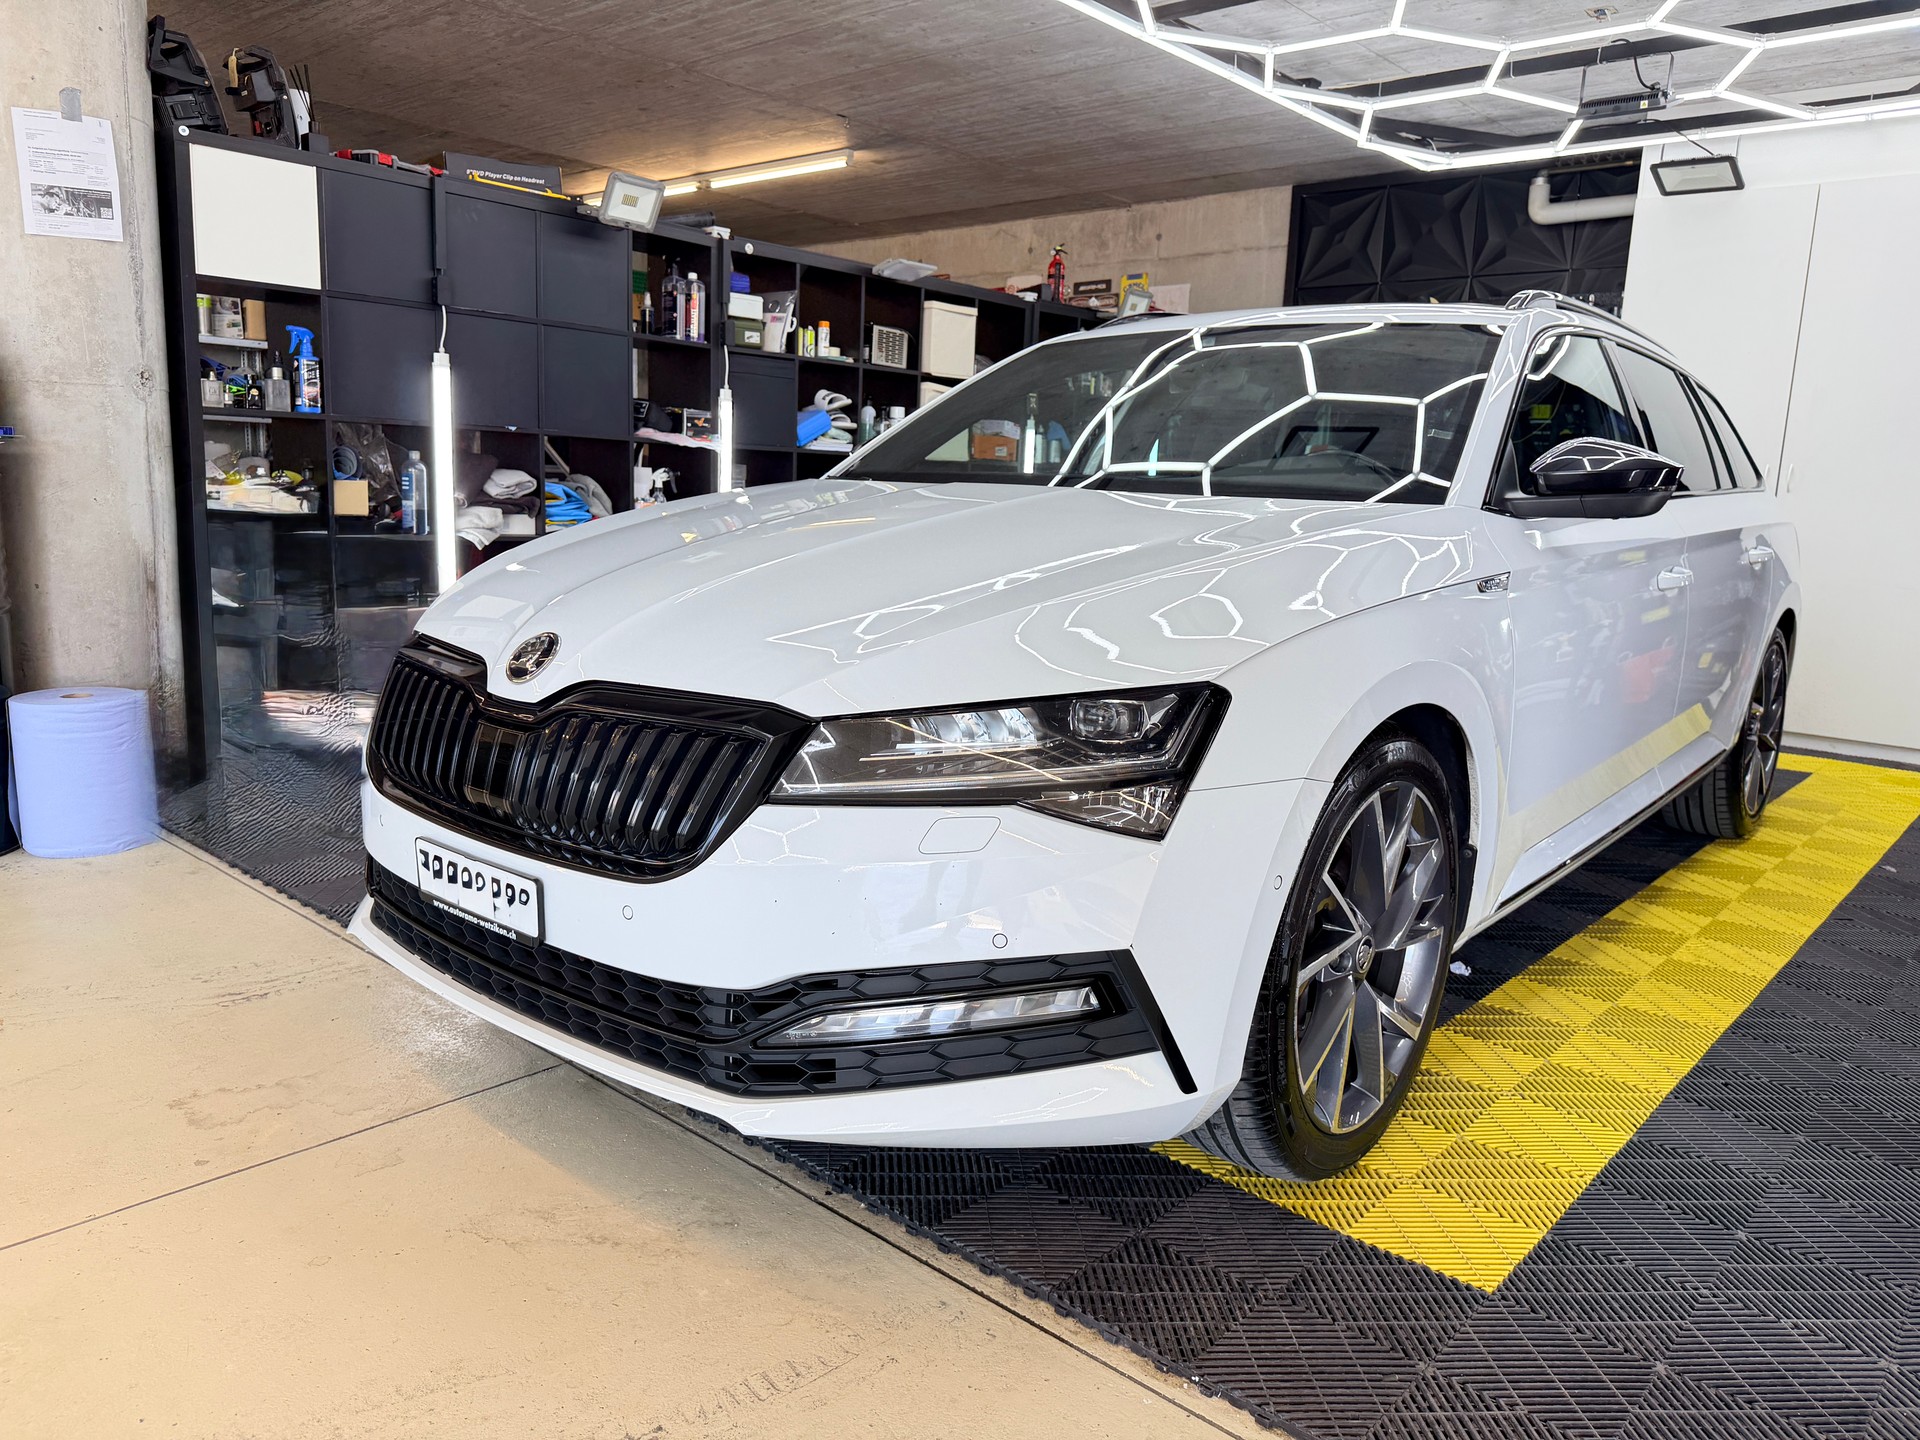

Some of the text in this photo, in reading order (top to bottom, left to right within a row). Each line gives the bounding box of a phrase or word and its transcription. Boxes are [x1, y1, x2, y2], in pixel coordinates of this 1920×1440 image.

[486, 171, 502, 179] Player
[522, 176, 545, 184] Headrest
[433, 900, 516, 940] www.autorama-wetzikon.ch
